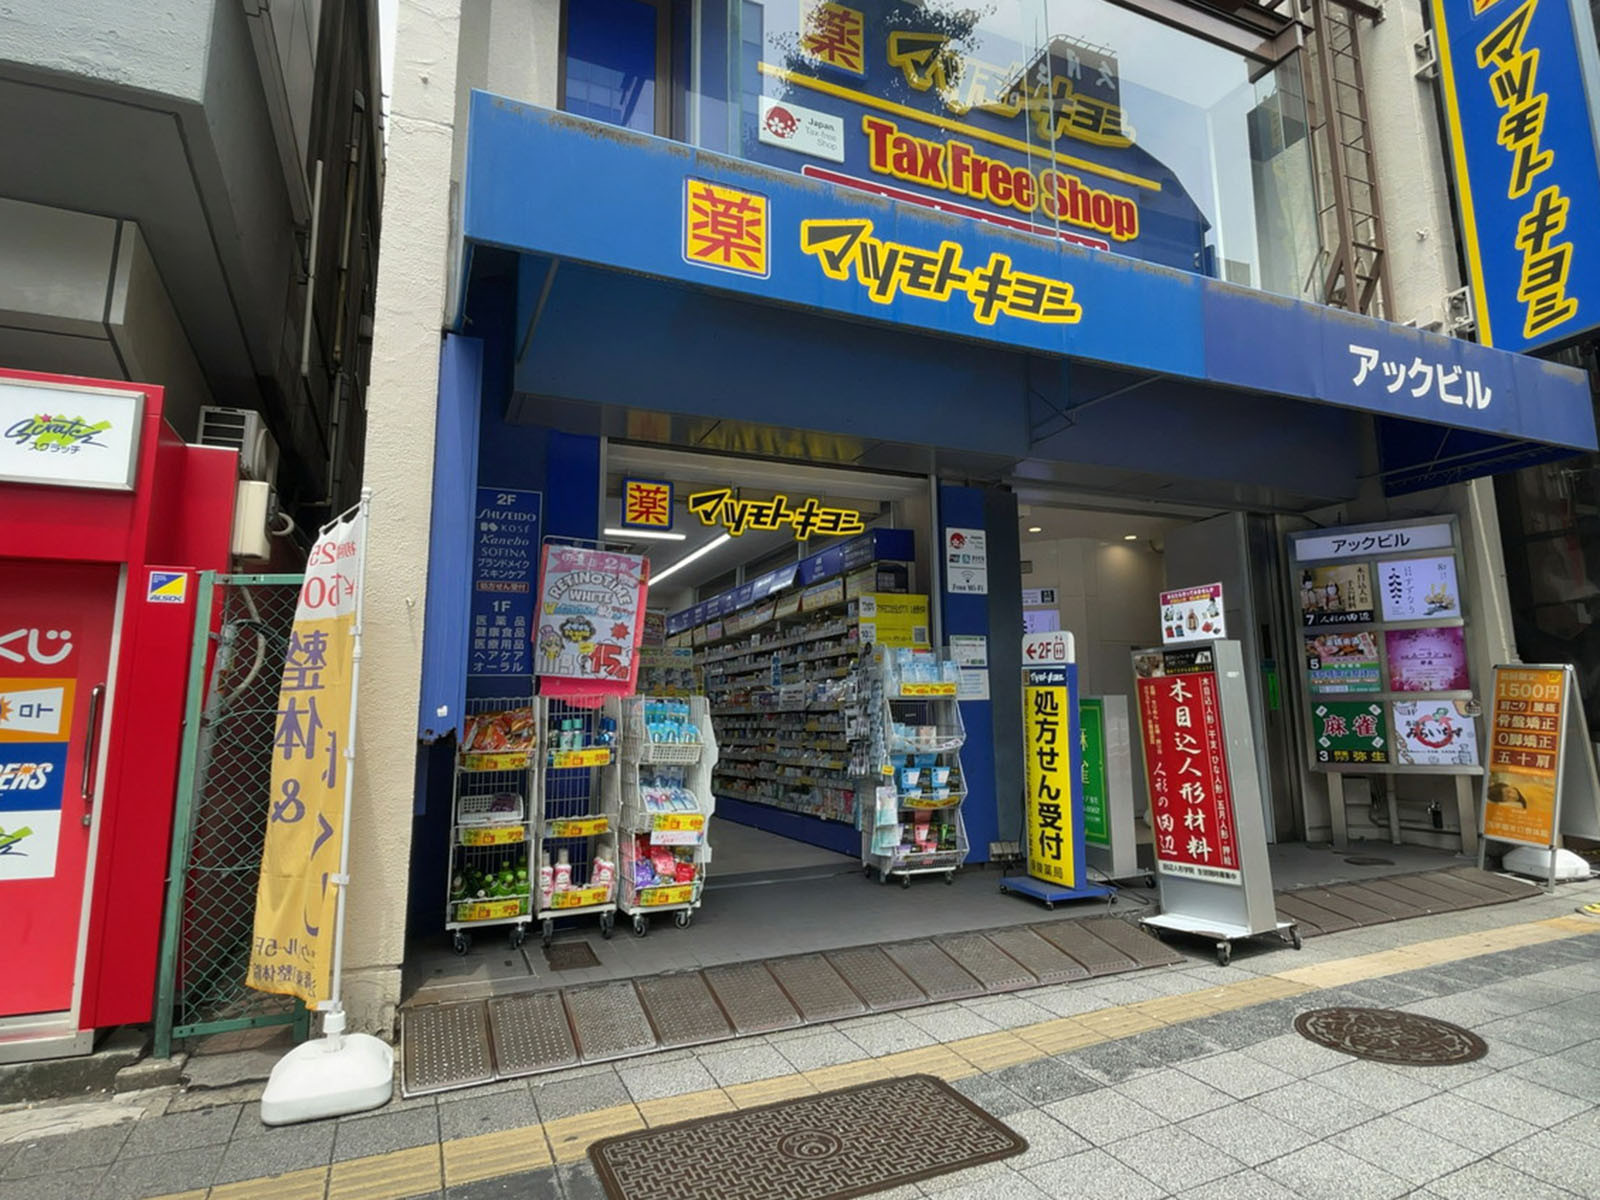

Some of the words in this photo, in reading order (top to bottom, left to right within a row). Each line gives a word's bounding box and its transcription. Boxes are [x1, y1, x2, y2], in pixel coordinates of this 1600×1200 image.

[1477, 1, 1577, 338] マツモトキヨシ
[863, 116, 946, 189] Tax
[949, 142, 1038, 212] Free
[1043, 171, 1138, 239] Shop
[692, 187, 762, 269] 薬
[801, 219, 1081, 325] マツモトキヨシ
[1348, 344, 1492, 410] アックビル
[28, 441, 82, 455] スクラッチ
[496, 493, 517, 506] 2F
[476, 508, 537, 522] SHISEIDO
[628, 484, 667, 524] 薬
[688, 487, 865, 541] マツモトキヨシ
[479, 533, 530, 547] Kanebo
[1331, 533, 1411, 553] アックビル
[480, 546, 528, 558] SOFINA
[477, 557, 531, 570] ブランドメイク
[479, 569, 526, 580] スキンケア
[568, 588, 614, 605] WHITE
[492, 600, 512, 612] 1F
[1305, 614, 1314, 626] 7
[474, 626, 526, 639] 健康食品
[473, 650, 524, 662] ヘアケア
[1038, 642, 1052, 659] 2F
[472, 661, 524, 673] オーラル
[1309, 658, 1320, 670] 5
[1499, 683, 1560, 700] 1500円
[1323, 714, 1378, 737] 麻雀
[1319, 750, 1329, 762] 3
[0, 762, 54, 790] ERS
[1033, 689, 1064, 861] 処方せん受付
[1168, 678, 1214, 864] 木目込人形材料
